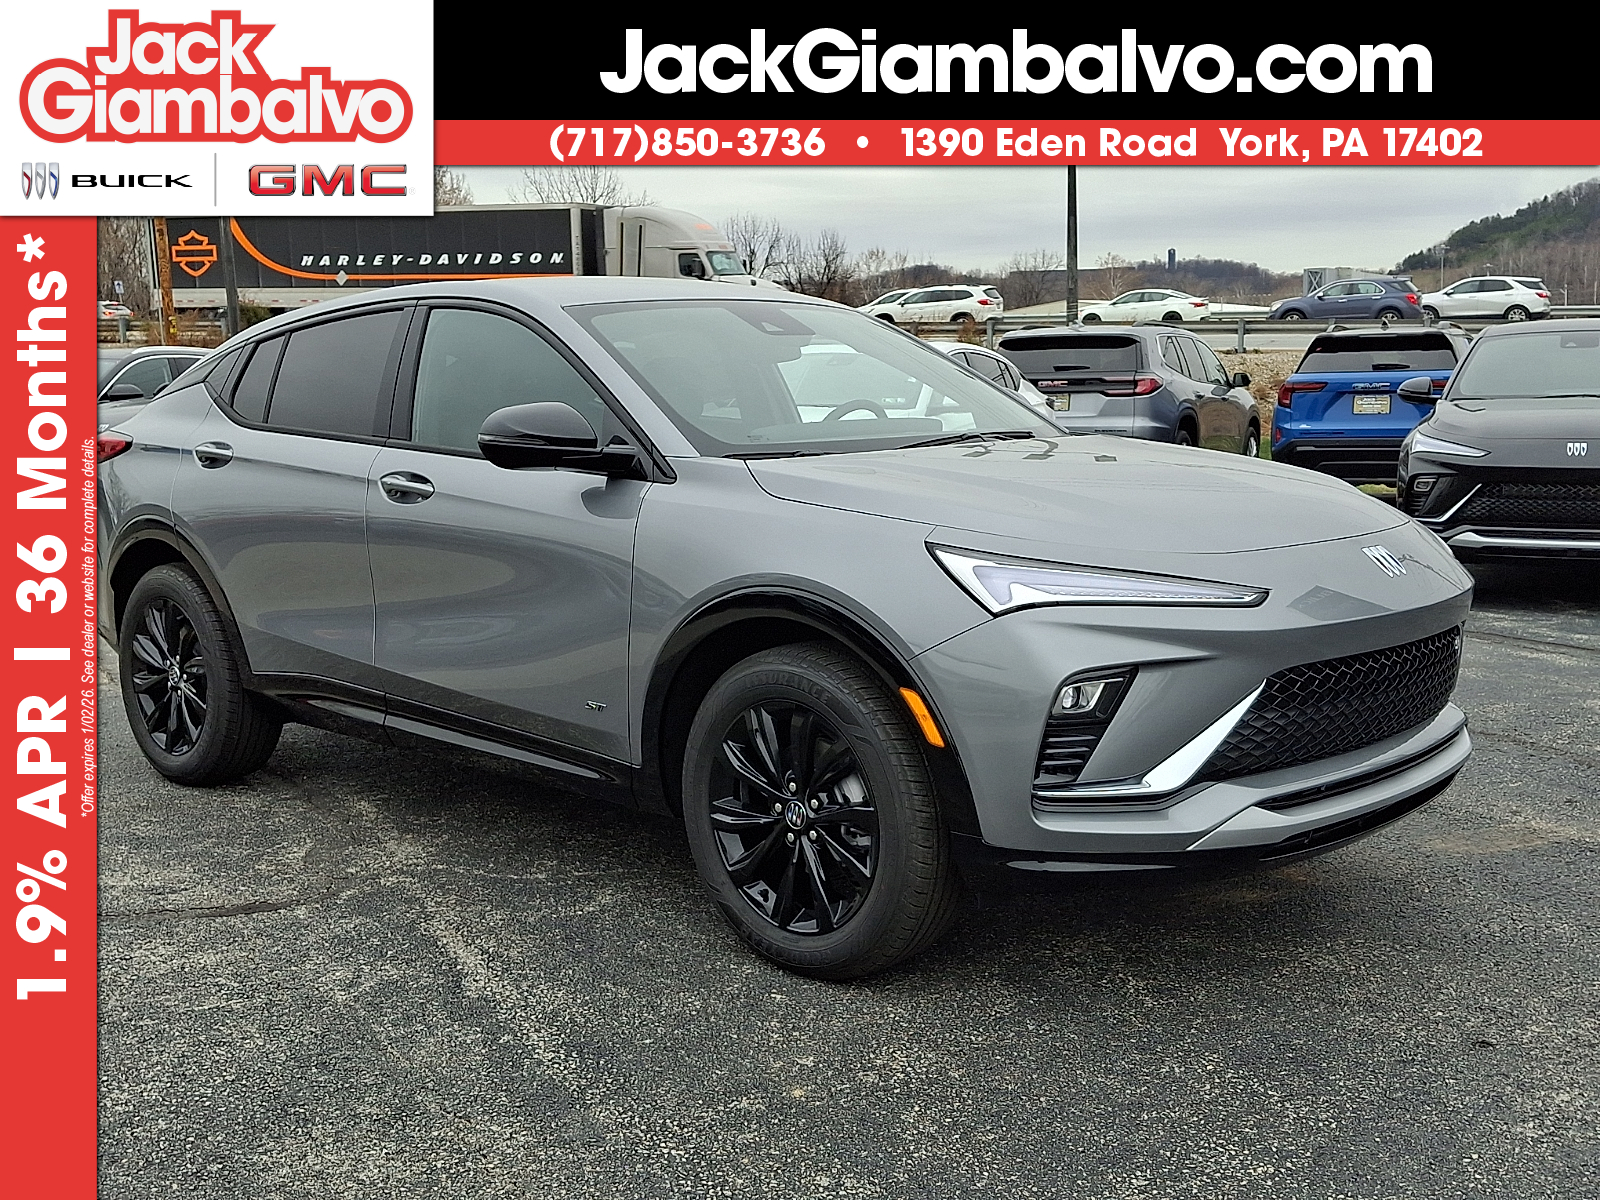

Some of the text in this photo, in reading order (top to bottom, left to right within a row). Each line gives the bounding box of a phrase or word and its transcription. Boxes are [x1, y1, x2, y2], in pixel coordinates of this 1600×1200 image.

[300, 252, 564, 267] HARLEY-DAVIDSON
[1037, 380, 1069, 388] GMC
[1351, 382, 1391, 391] GMC
